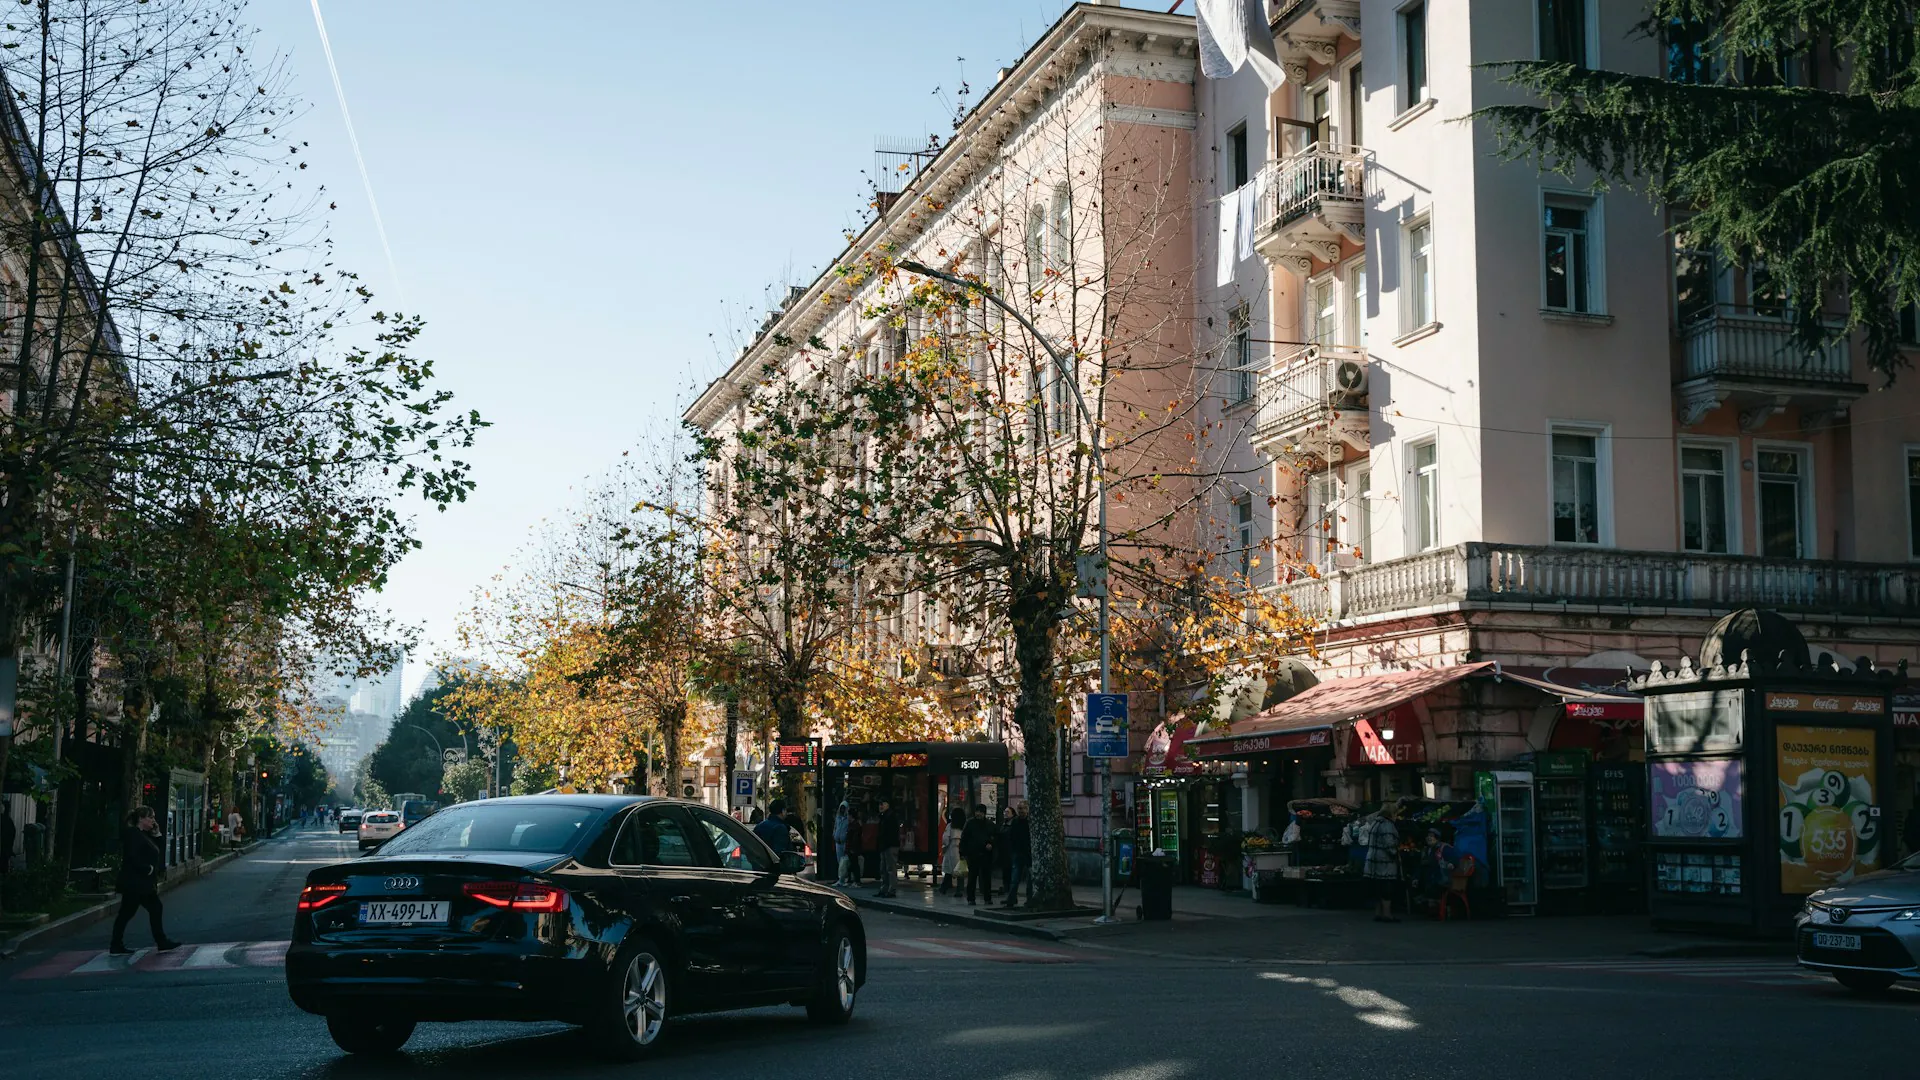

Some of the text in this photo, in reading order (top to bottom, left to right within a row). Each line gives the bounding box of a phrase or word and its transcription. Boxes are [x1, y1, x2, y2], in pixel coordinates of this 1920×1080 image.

[1359, 743, 1412, 763] MARKET
[961, 760, 980, 770] 15:00
[739, 779, 750, 794] P
[1828, 775, 1840, 790] 9
[1710, 791, 1718, 802] 9
[1818, 789, 1830, 804] 3
[1668, 809, 1674, 825] 1
[1718, 812, 1726, 827] 2
[1783, 811, 1793, 837] 1
[1858, 810, 1872, 834] 2
[369, 903, 438, 920] XX-499-LX
